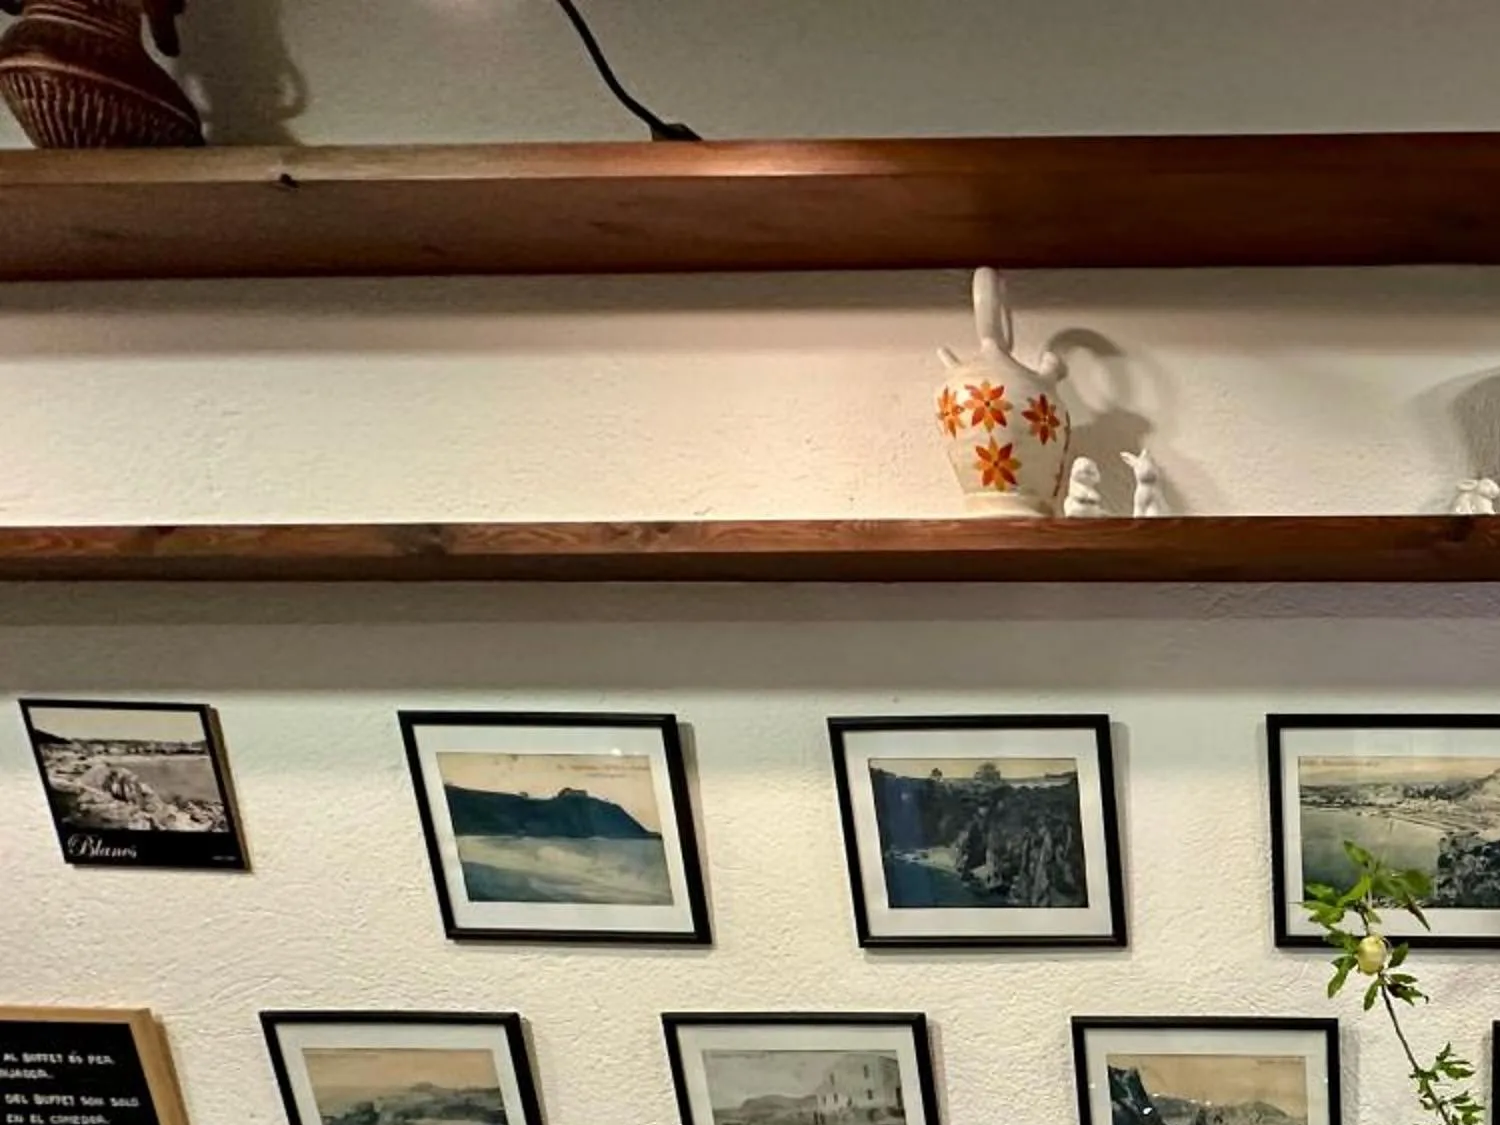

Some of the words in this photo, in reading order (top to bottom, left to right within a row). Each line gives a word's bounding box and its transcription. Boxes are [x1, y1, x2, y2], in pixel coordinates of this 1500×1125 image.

[22, 1051, 63, 1064] BUFFET
[4, 1093, 28, 1105] DEL
[33, 1093, 75, 1106] BUFFET
[6, 1113, 24, 1124] EN
[29, 1113, 44, 1124] EL
